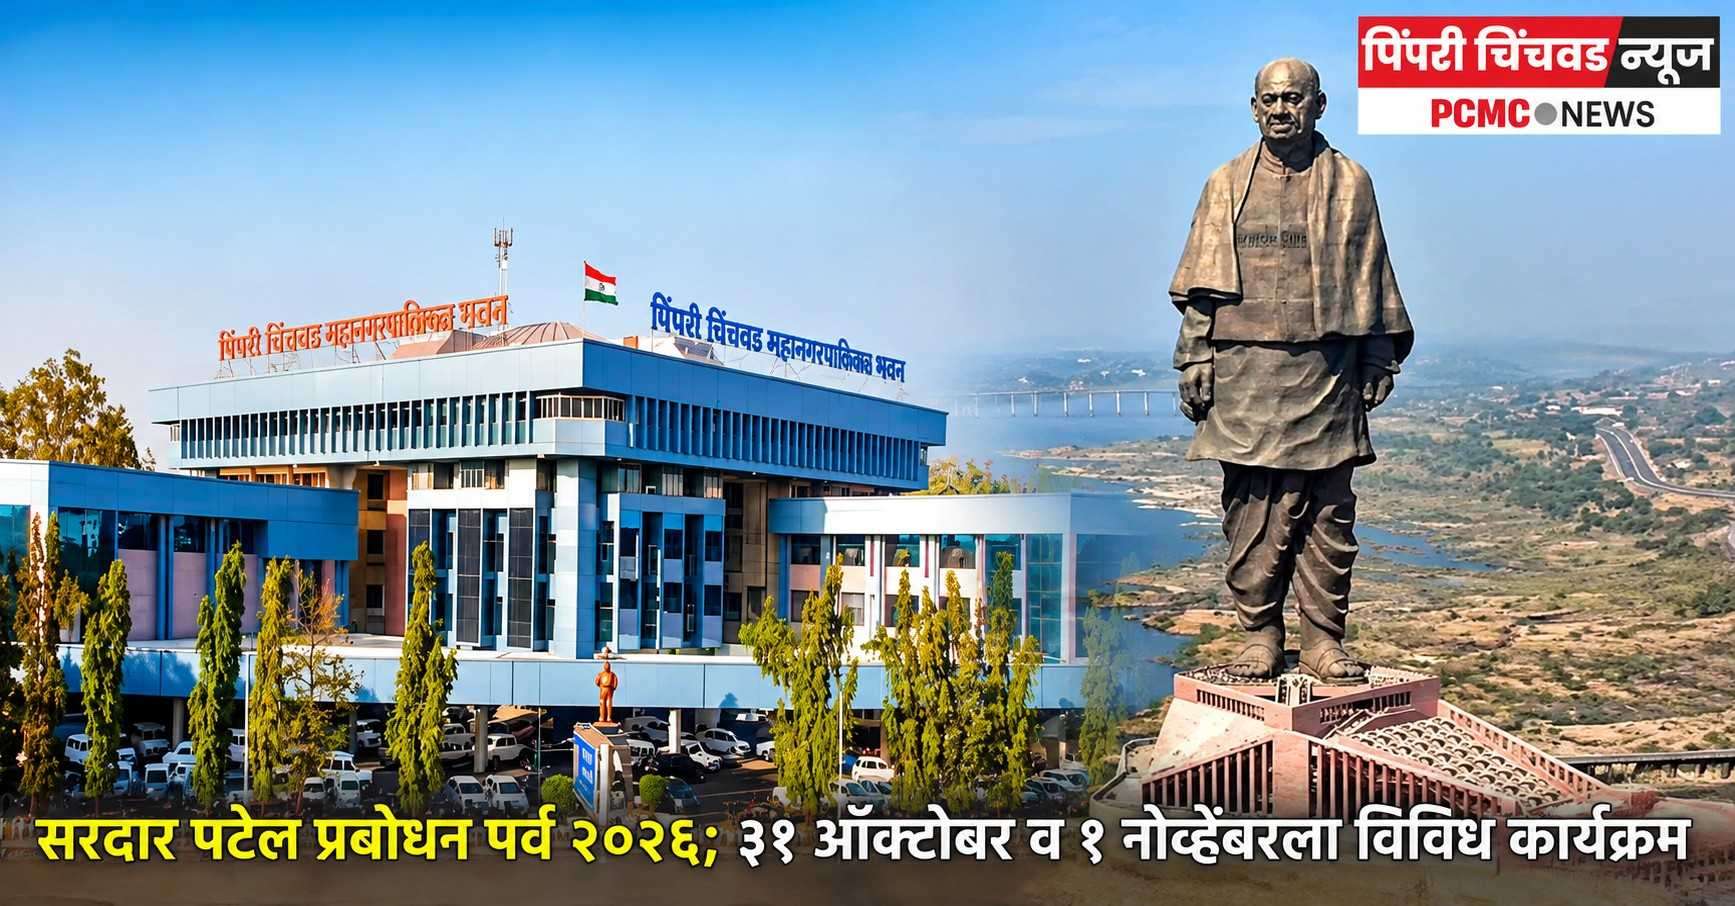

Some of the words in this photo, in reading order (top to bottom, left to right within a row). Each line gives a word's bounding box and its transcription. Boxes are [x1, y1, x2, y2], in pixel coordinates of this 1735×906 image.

[218, 326, 261, 361] पिंपरी
[650, 292, 702, 340] पिंपरी
[706, 306, 763, 352] चिंचवड
[876, 355, 906, 383] भवन
